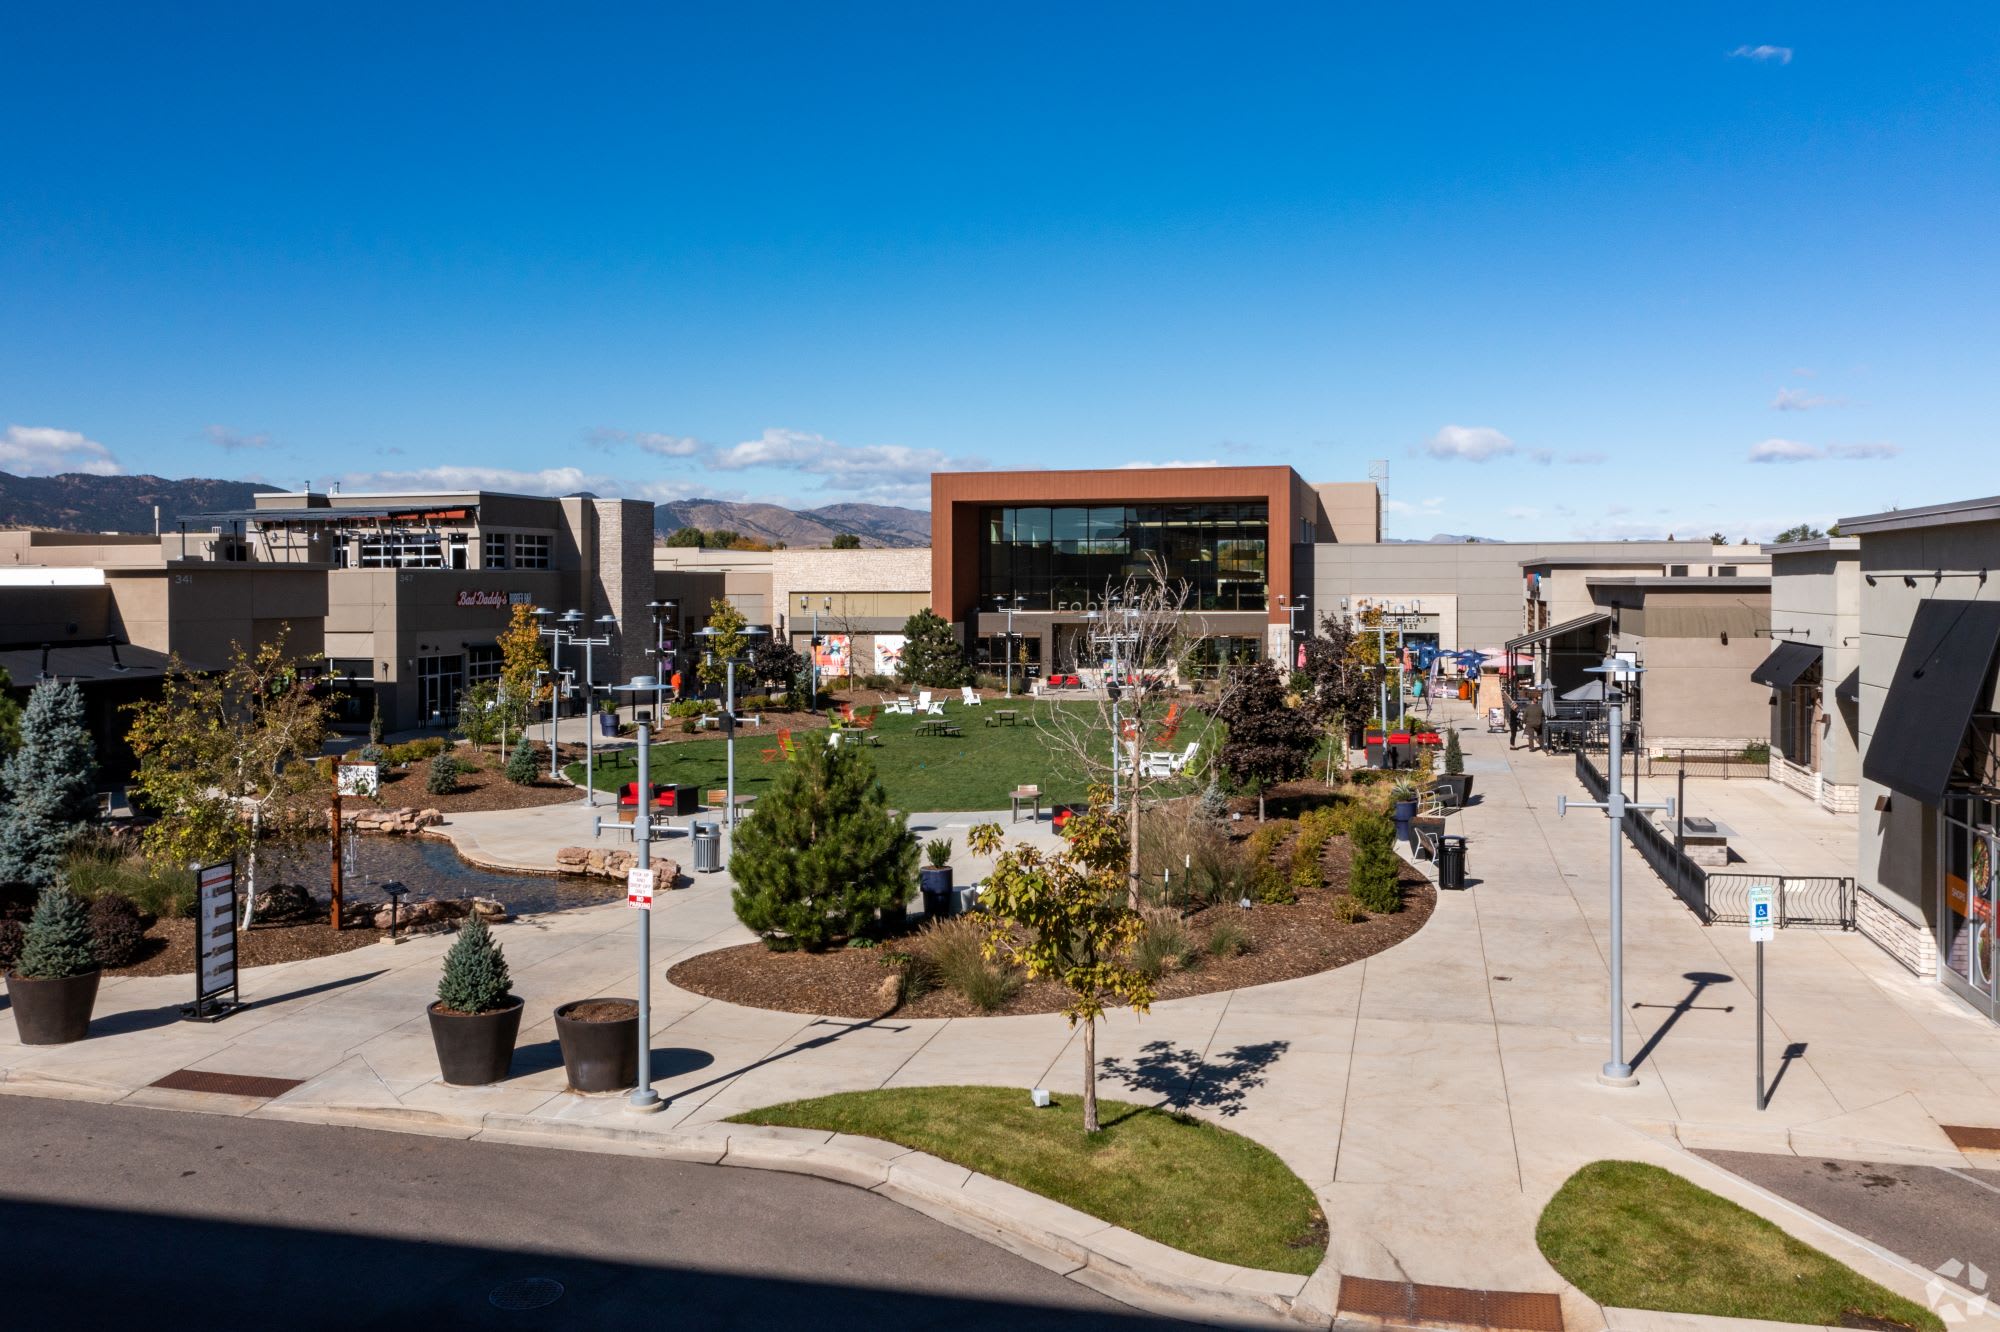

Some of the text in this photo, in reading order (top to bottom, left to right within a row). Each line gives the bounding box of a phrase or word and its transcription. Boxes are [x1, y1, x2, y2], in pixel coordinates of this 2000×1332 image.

[175, 574, 193, 584] 341
[458, 591, 507, 608] Bad Daddy's
